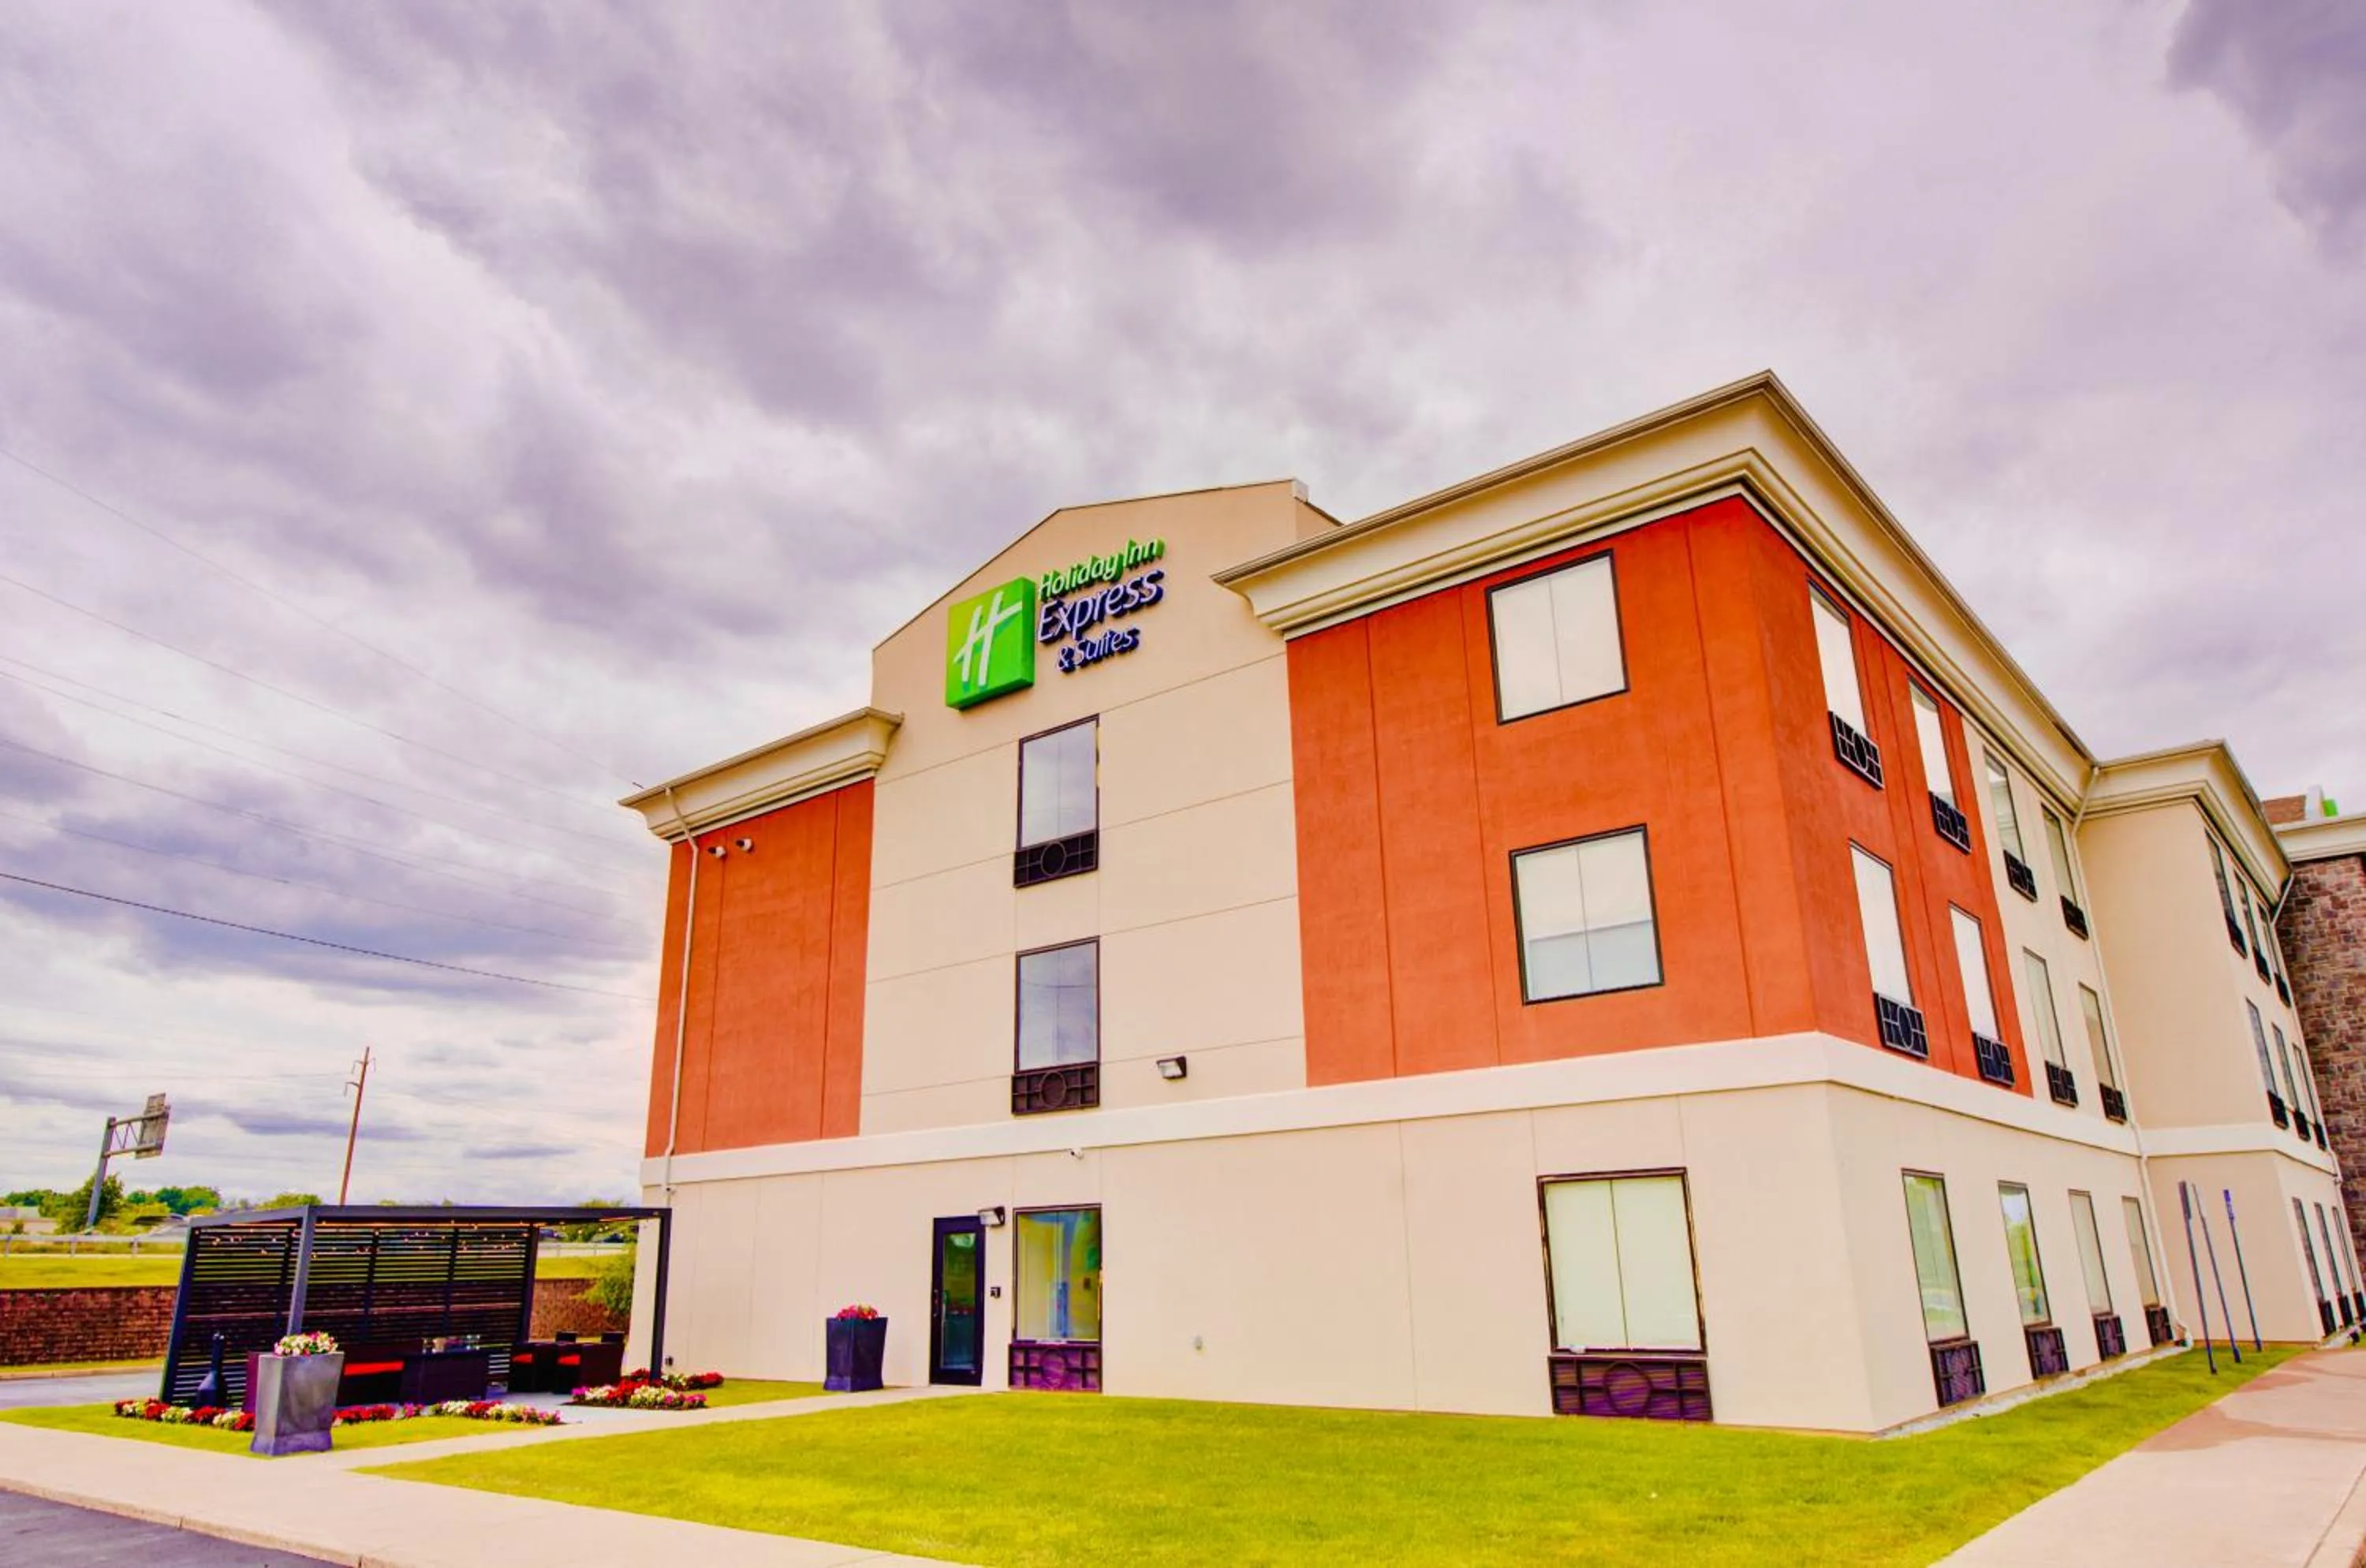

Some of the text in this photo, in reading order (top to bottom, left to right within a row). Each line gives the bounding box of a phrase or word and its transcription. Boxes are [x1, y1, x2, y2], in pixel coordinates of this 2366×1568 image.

[1038, 538, 1166, 601] Holiday Inn
[1036, 568, 1166, 644] Express
[1057, 625, 1140, 673] & Suites
